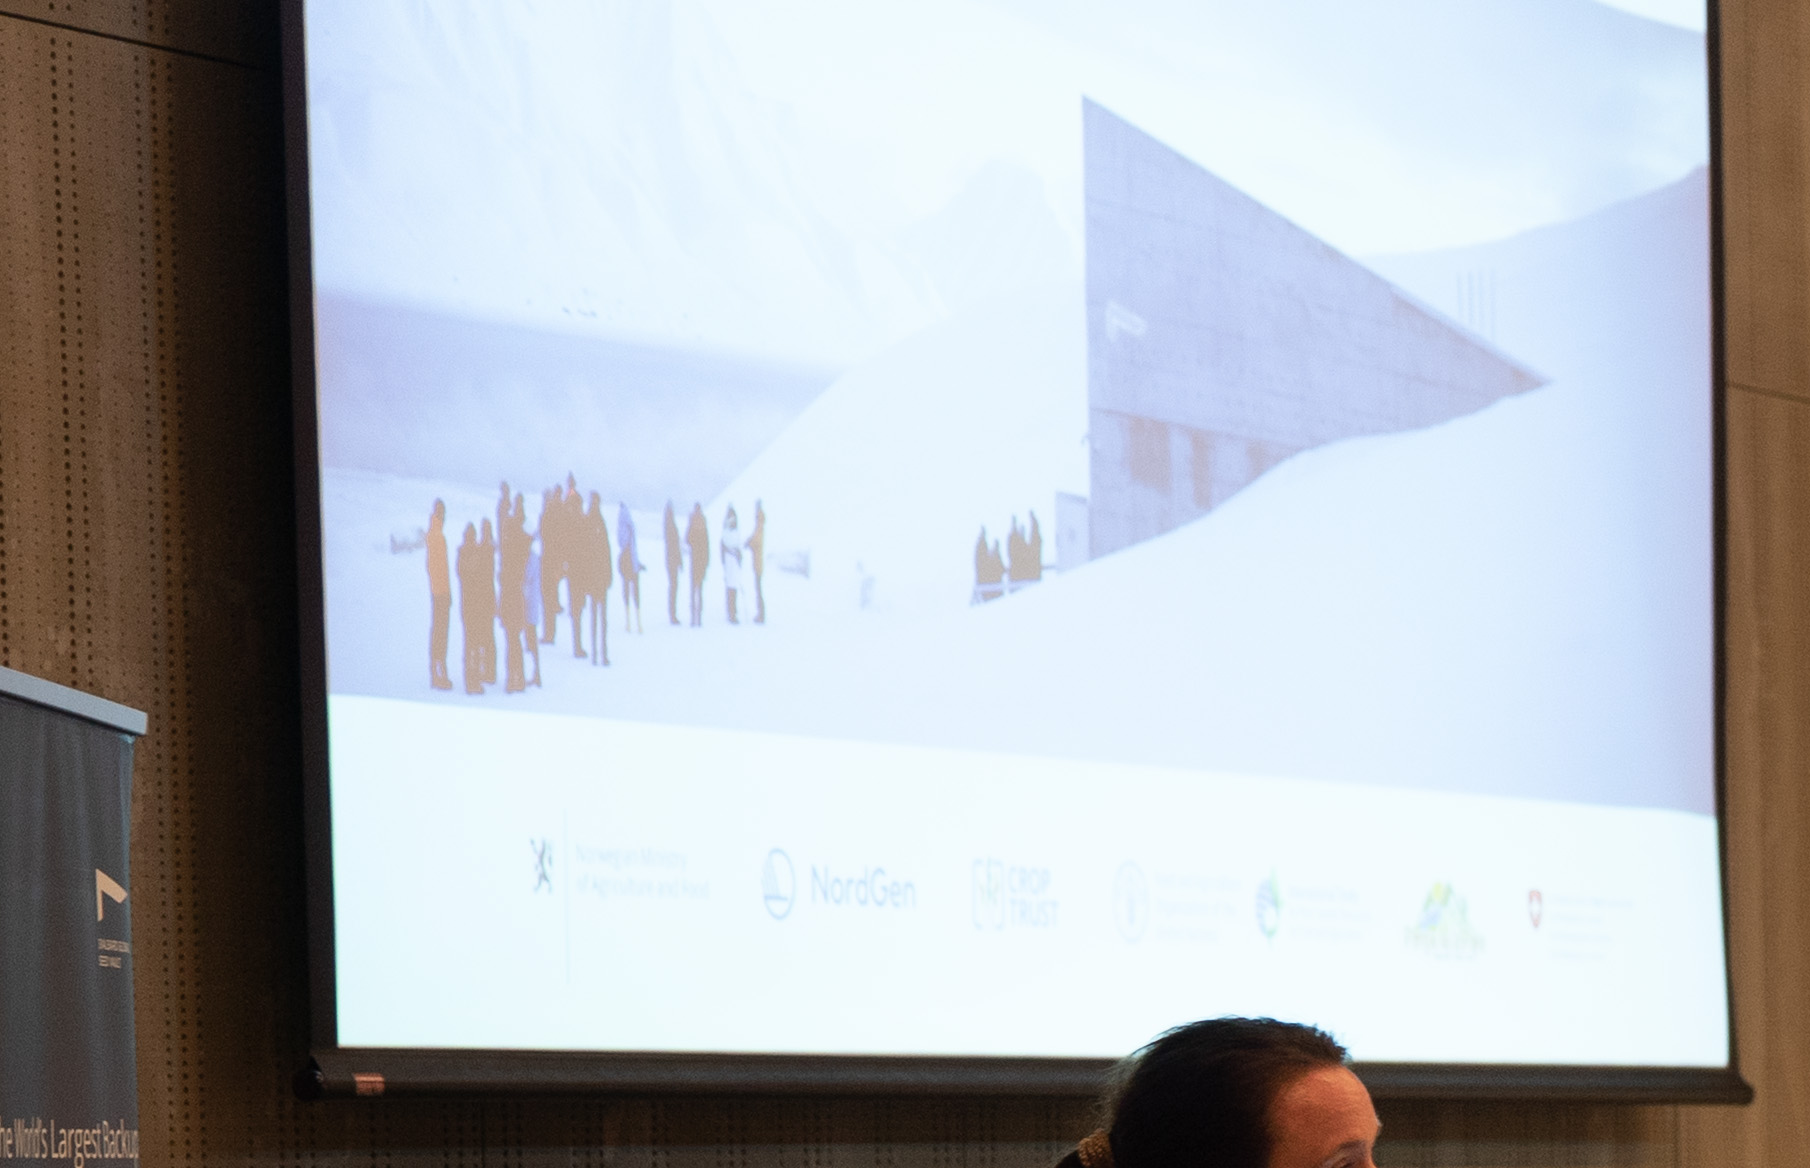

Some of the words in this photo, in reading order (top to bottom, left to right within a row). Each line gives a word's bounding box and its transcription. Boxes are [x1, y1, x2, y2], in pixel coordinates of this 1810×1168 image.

[811, 864, 917, 908] NordGen
[1008, 866, 1052, 895] CROP
[1009, 898, 1060, 927] TRUST
[14, 1117, 48, 1158] World's
